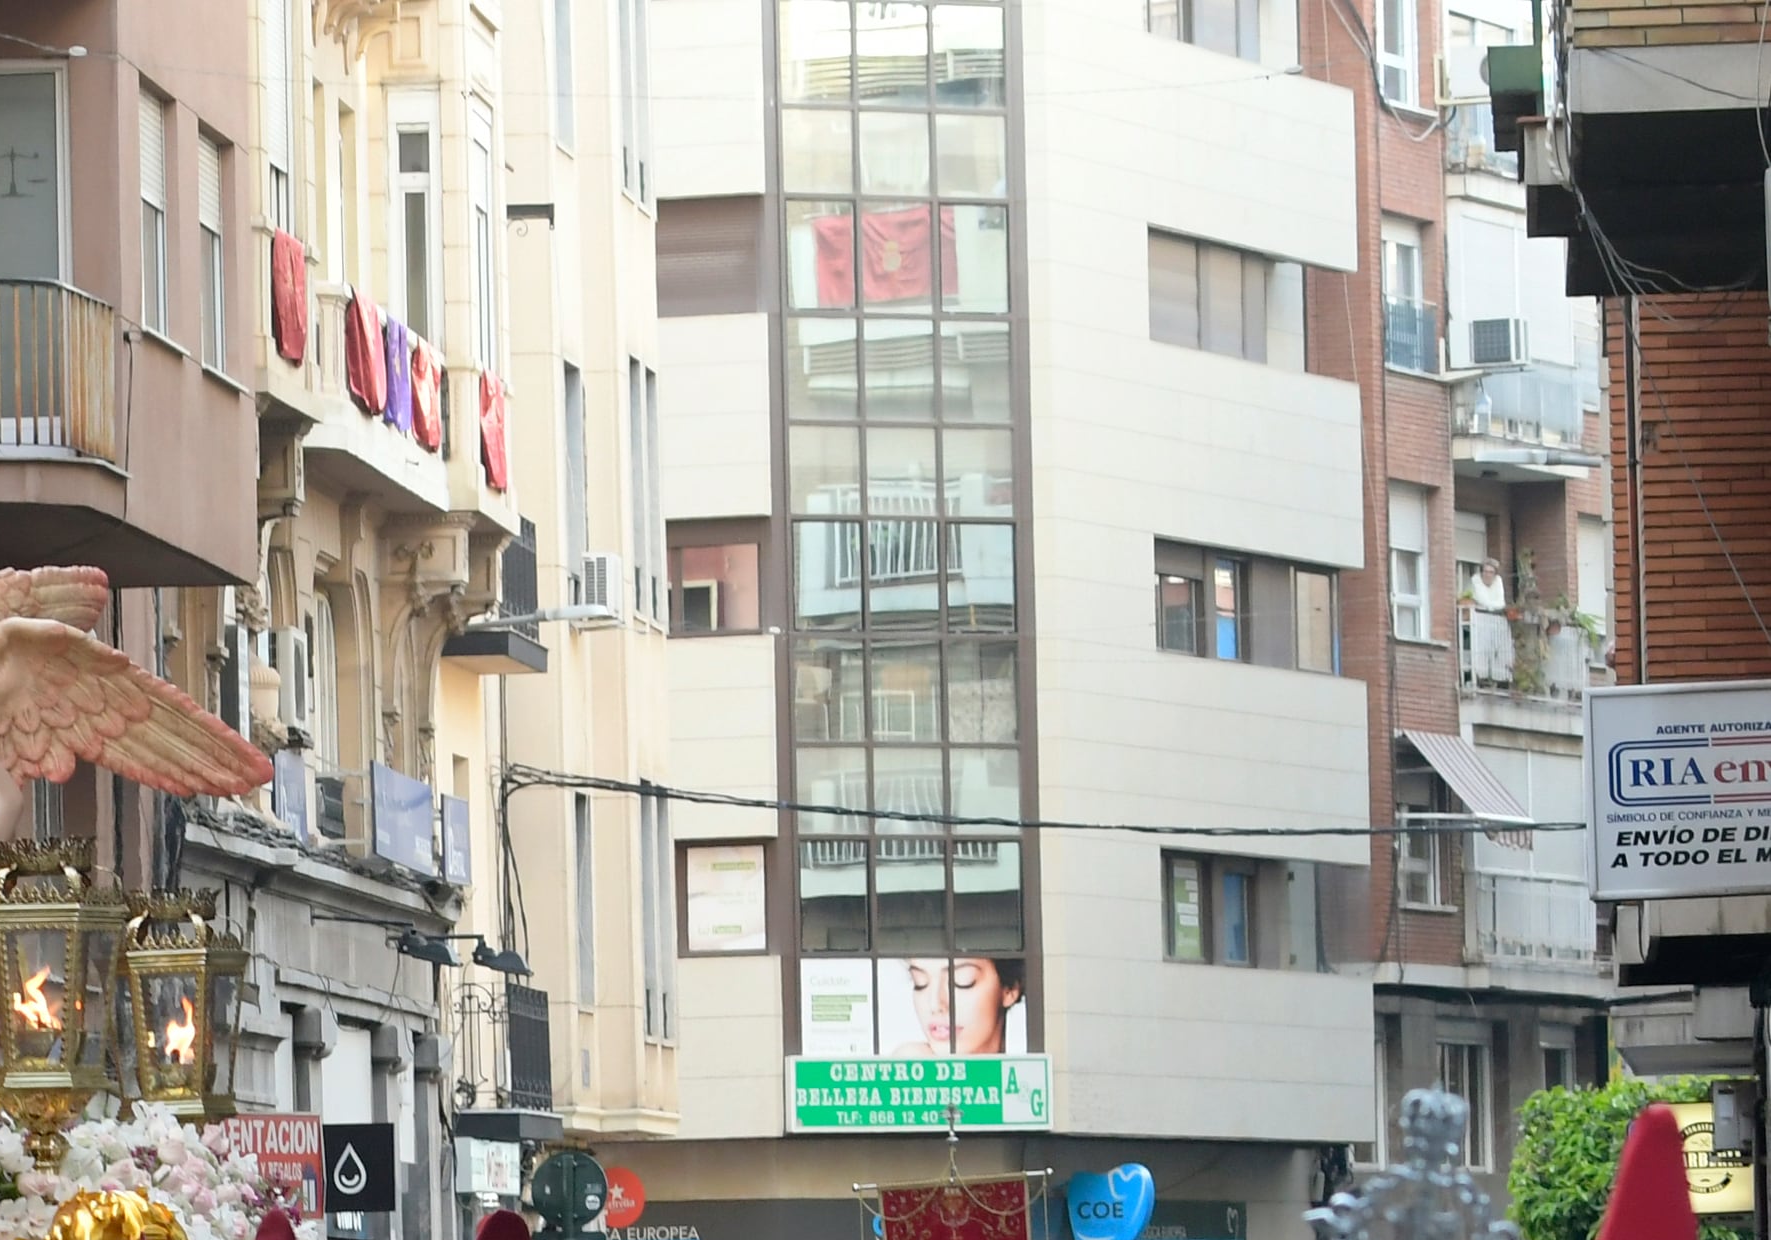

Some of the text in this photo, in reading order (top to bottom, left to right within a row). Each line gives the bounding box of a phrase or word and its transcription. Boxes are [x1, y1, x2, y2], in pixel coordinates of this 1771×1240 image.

[1656, 724, 1705, 735] AGENTE
[1629, 757, 1708, 787] RIA
[1607, 811, 1656, 823] SÍMBOLO
[1660, 811, 1674, 821] DE
[1678, 809, 1742, 820] CONFIANZA
[1616, 825, 1771, 847] ENVÍO DE DI
[1611, 852, 1628, 868] A
[1640, 849, 1709, 867] TODO
[1717, 847, 1747, 864] EL
[830, 1062, 967, 1082] CENTRO DE
[796, 1087, 1000, 1106] BELLEZA BIENESTAR
[836, 1111, 862, 1124] TLF:
[902, 1111, 915, 1124] 12
[921, 1111, 938, 1124] 40
[221, 1119, 318, 1155] ENTACION
[1077, 1201, 1124, 1220] COE
[627, 1225, 700, 1240] EUROPEA
